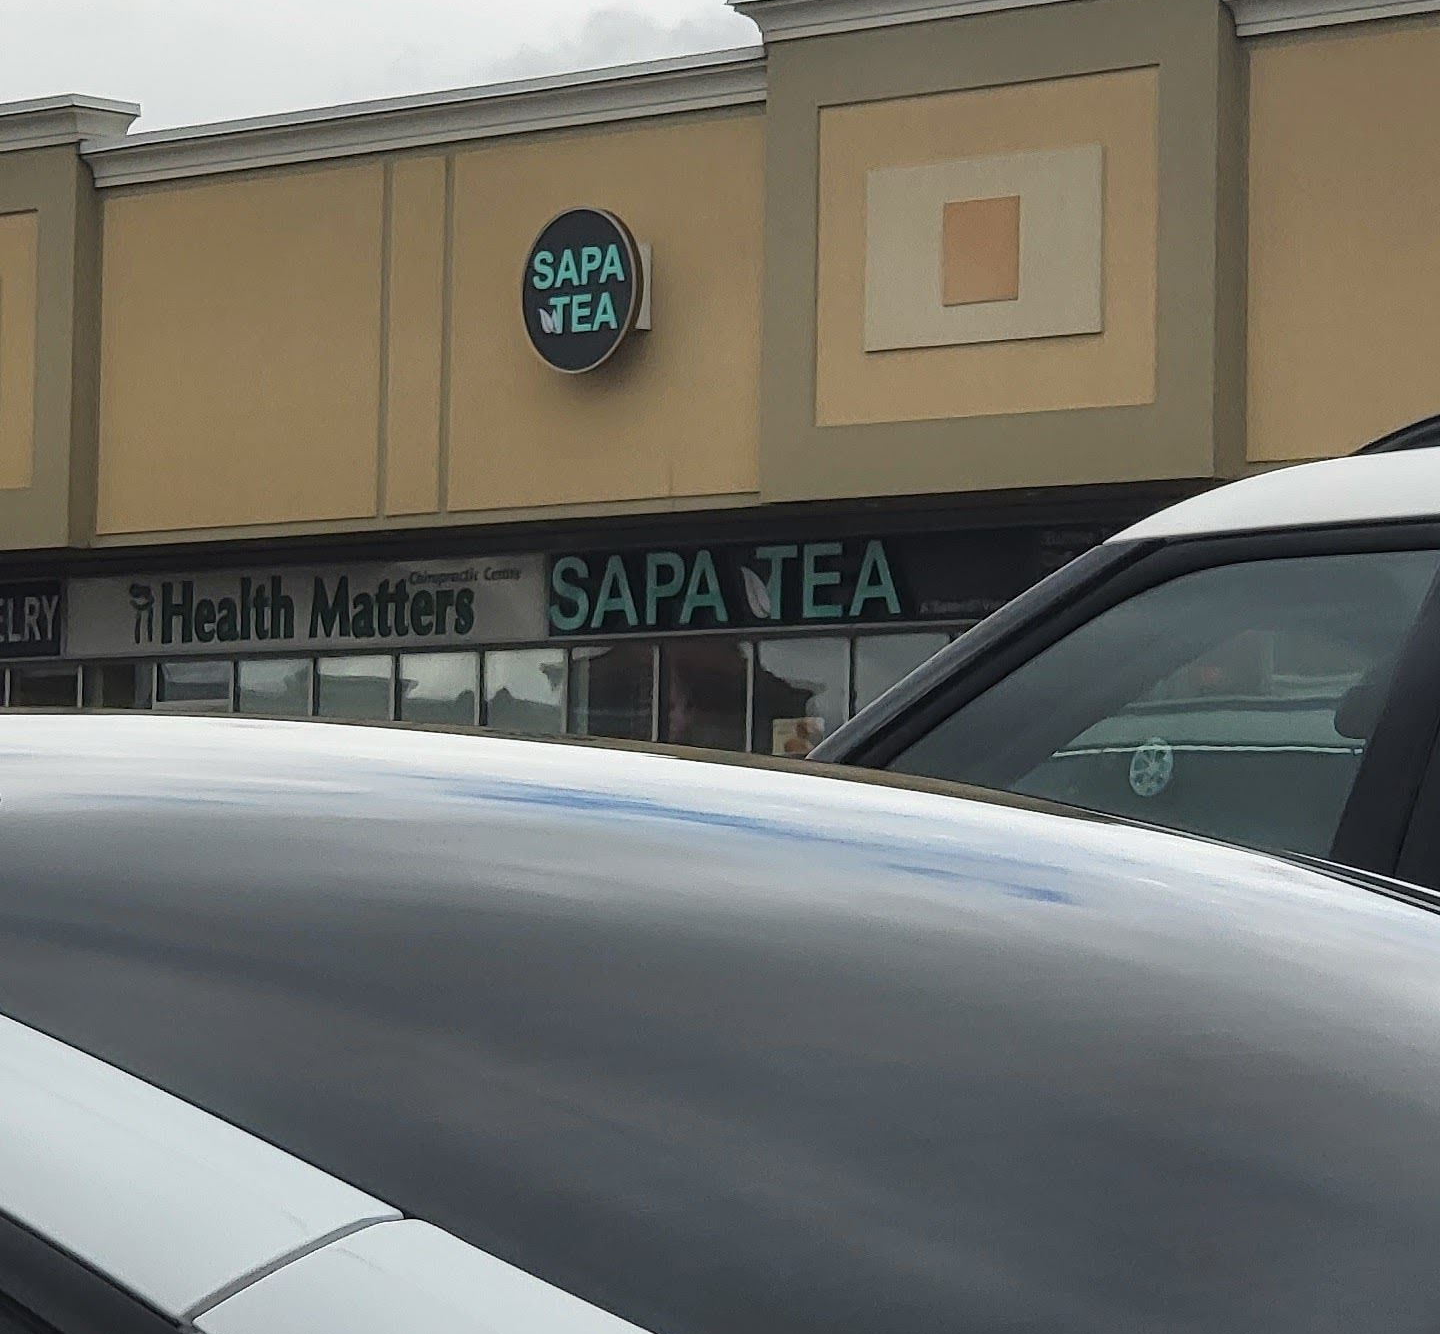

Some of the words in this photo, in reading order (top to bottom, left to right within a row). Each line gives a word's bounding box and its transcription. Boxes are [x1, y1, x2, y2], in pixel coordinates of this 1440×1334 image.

[533, 244, 625, 290] SAPA
[549, 292, 618, 335] TEA
[161, 576, 295, 644] Health
[309, 575, 475, 638] Matters
[550, 549, 728, 631] SAPA
[756, 540, 901, 620] TEA
